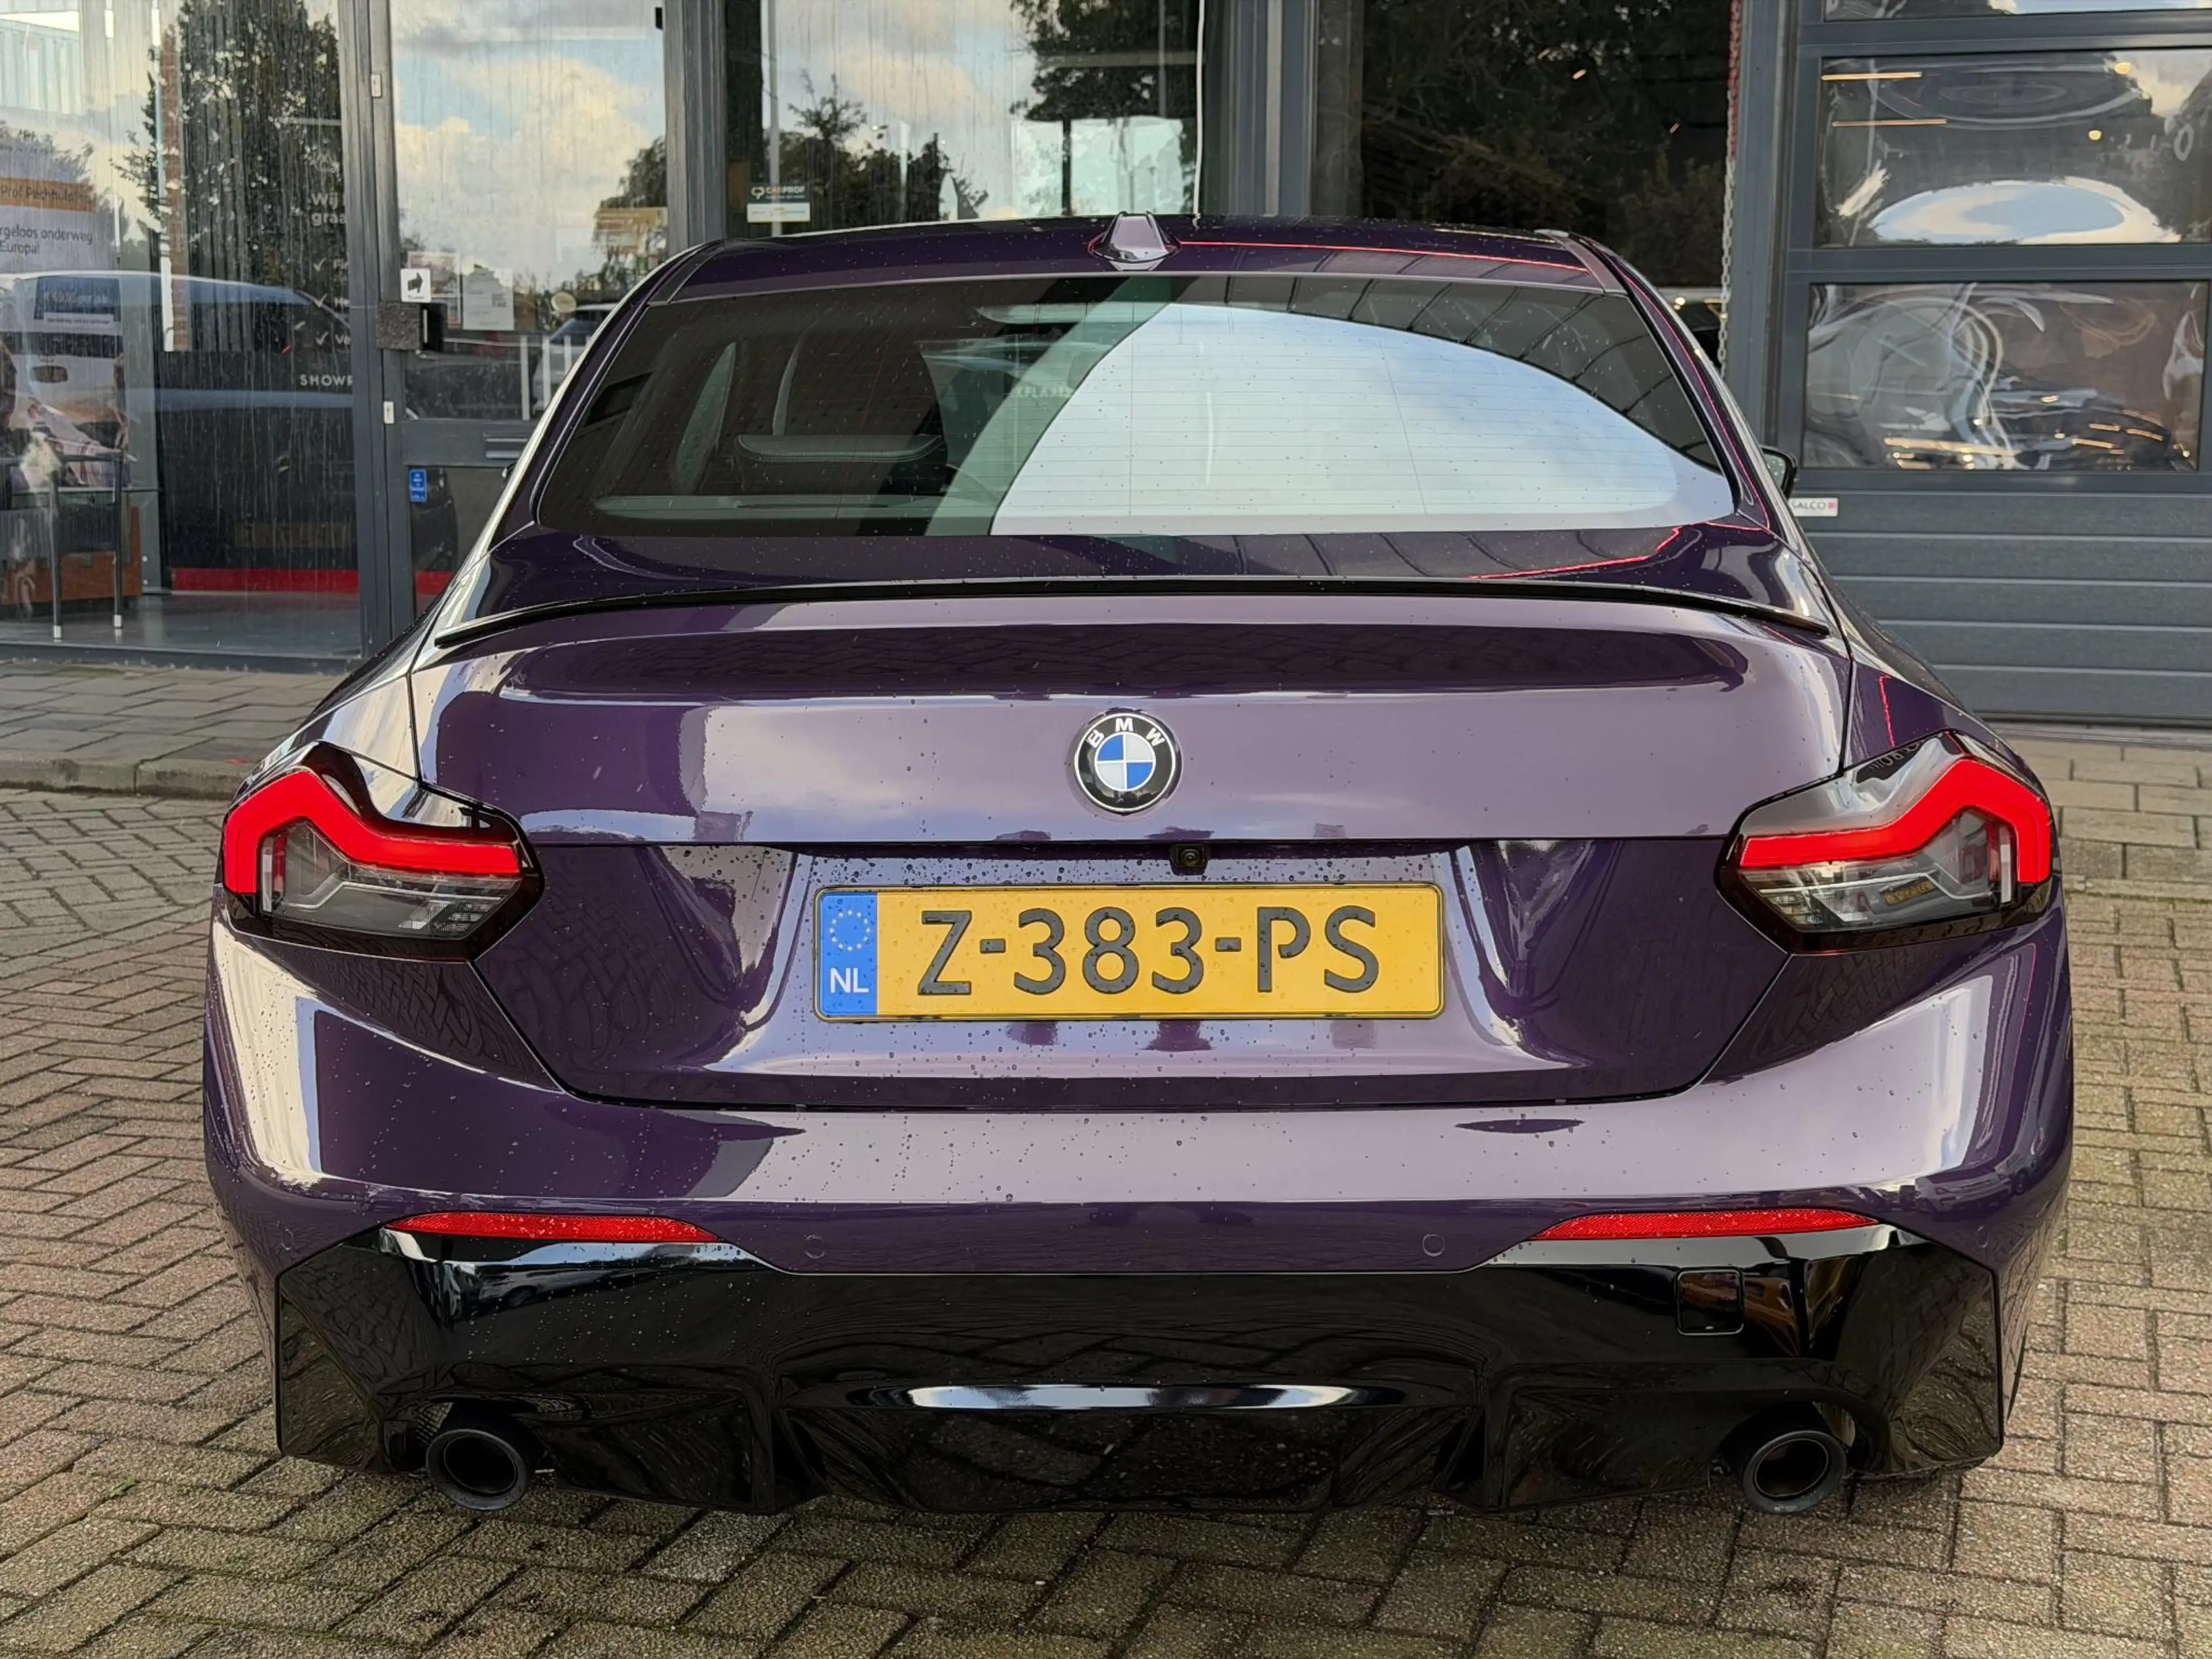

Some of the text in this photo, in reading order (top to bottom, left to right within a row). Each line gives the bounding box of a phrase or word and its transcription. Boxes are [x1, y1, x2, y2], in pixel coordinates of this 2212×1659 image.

[1086, 717, 1165, 749] BMW
[917, 905, 1379, 996] Z-383-PS
[830, 967, 869, 993] NL
